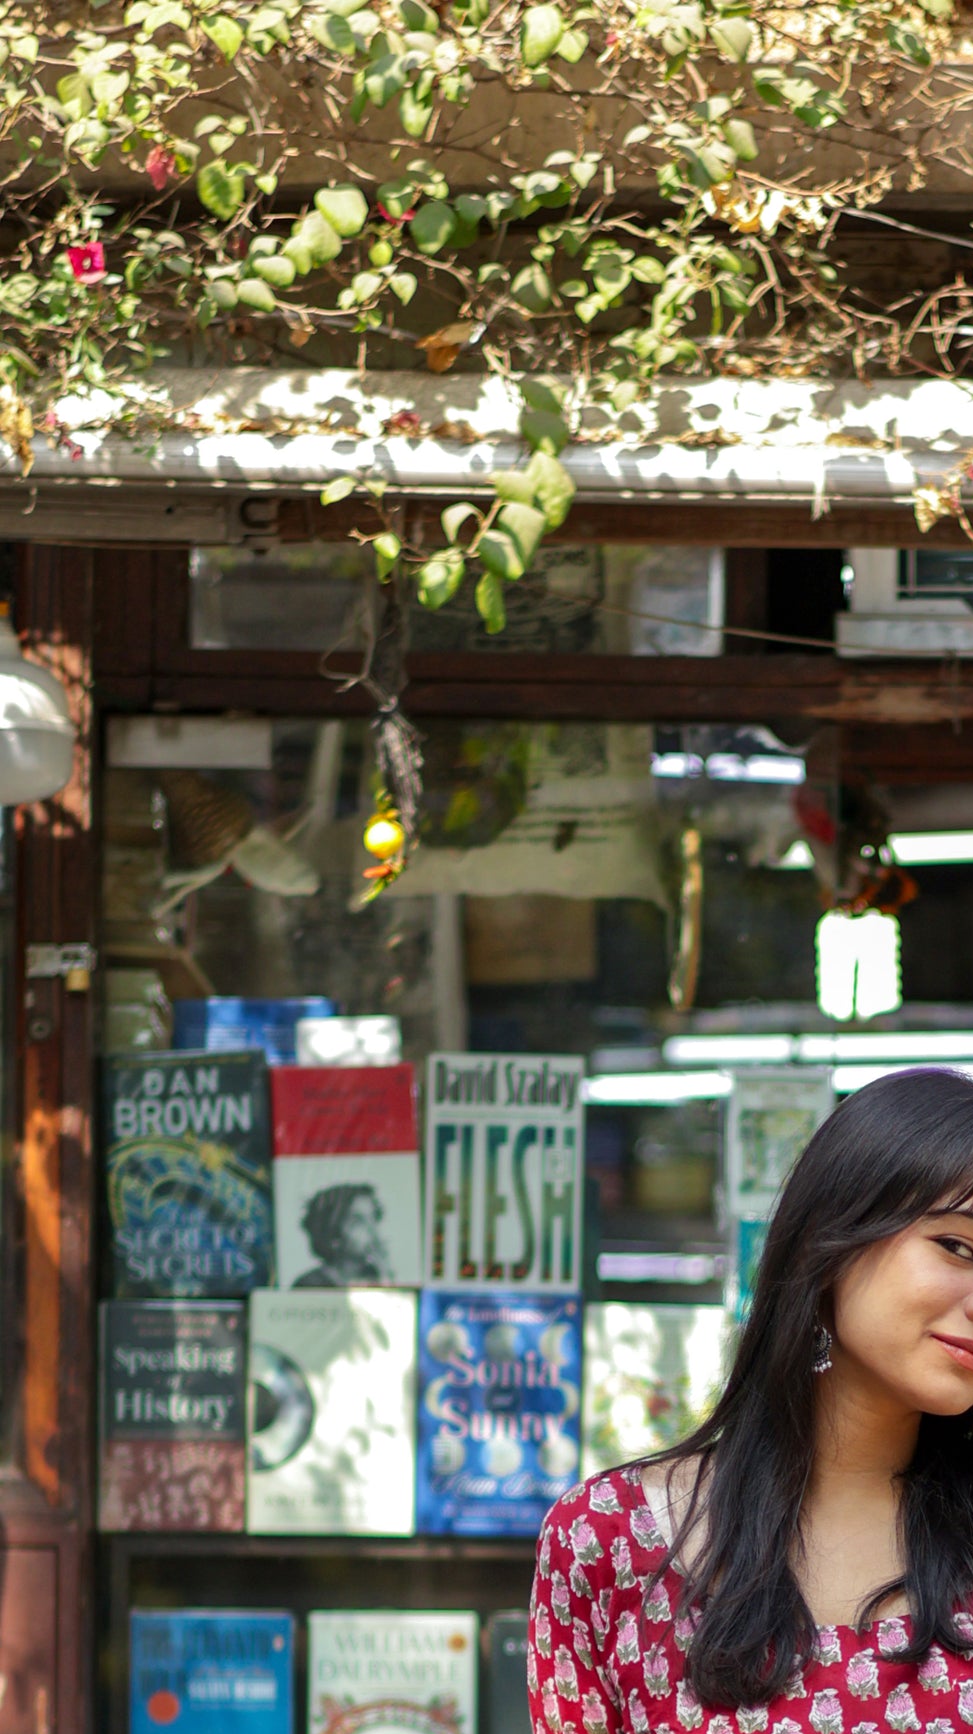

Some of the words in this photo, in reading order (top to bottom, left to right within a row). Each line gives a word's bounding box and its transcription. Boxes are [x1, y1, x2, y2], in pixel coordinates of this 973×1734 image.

[143, 1068, 219, 1096] DAN
[435, 1060, 497, 1104] David
[504, 1060, 577, 1110] Szalay
[114, 1095, 252, 1138] BROWN
[433, 1124, 576, 1281] FLESH
[113, 1343, 236, 1377] Speaking
[445, 1345, 561, 1388] Sonia
[114, 1389, 233, 1430] History
[440, 1398, 565, 1442] Sunny
[333, 1632, 449, 1653] WILLIAM
[317, 1660, 463, 1682] DALRYMPLE
